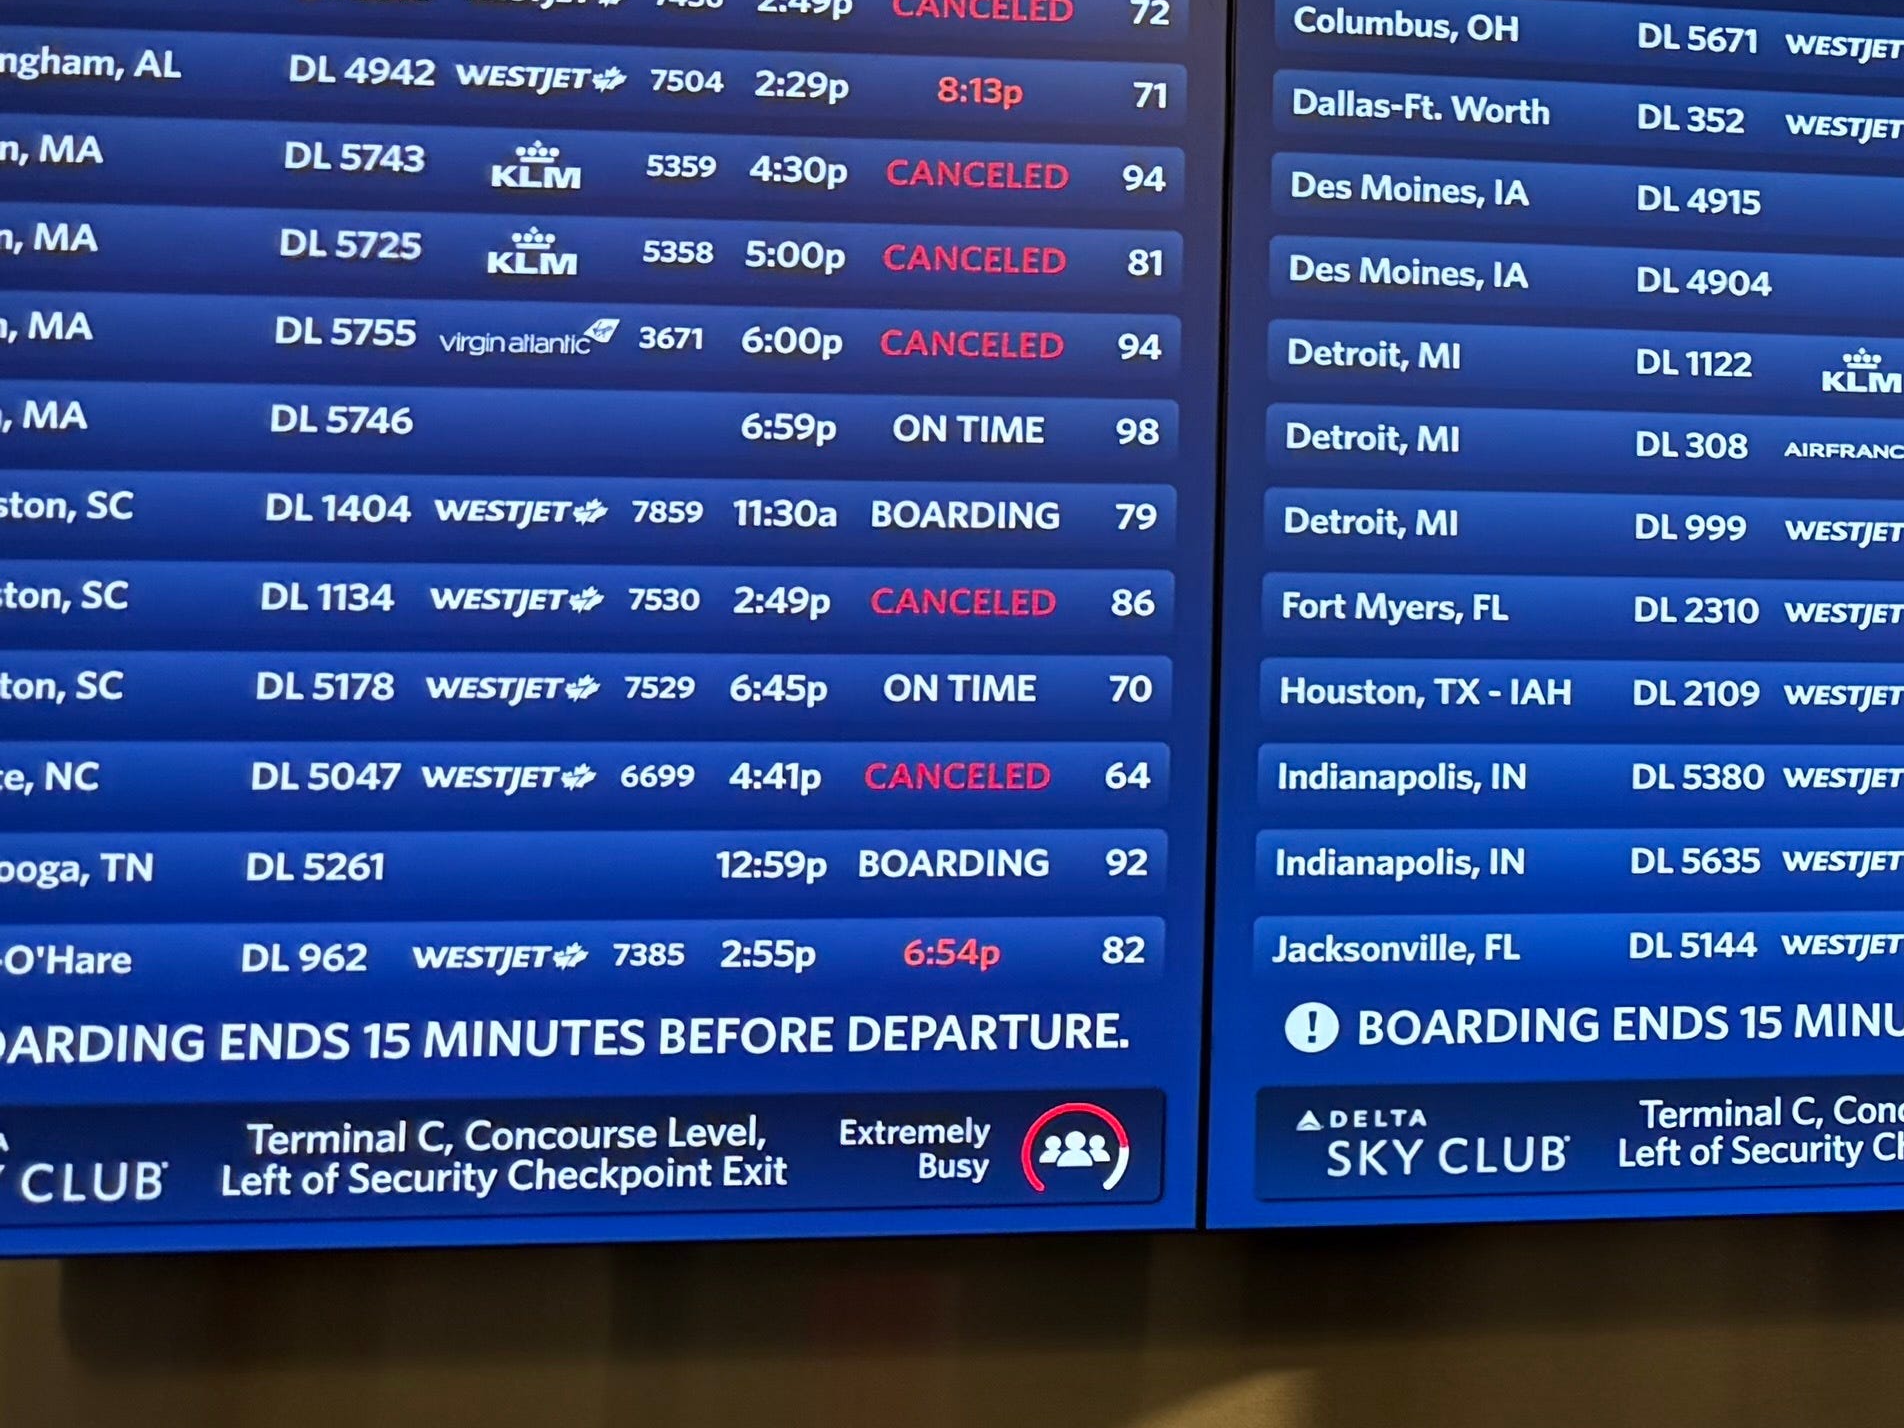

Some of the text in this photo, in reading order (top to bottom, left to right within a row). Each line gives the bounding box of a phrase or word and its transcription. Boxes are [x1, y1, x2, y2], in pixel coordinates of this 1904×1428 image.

[492, 165, 581, 189] KLM
[1359, 1008, 1599, 1045] BOARDING
[1614, 1006, 1728, 1041] ENDS
[1740, 1006, 1782, 1039] 15
[1330, 1109, 1427, 1128] DELTA
[1639, 1096, 1781, 1128] Terminal
[1792, 1096, 1823, 1129] C,
[1328, 1136, 1565, 1176] SKY CLUB
[1620, 1137, 1681, 1167] Left
[1690, 1135, 1723, 1165] of
[1732, 1127, 1864, 1168] Security
